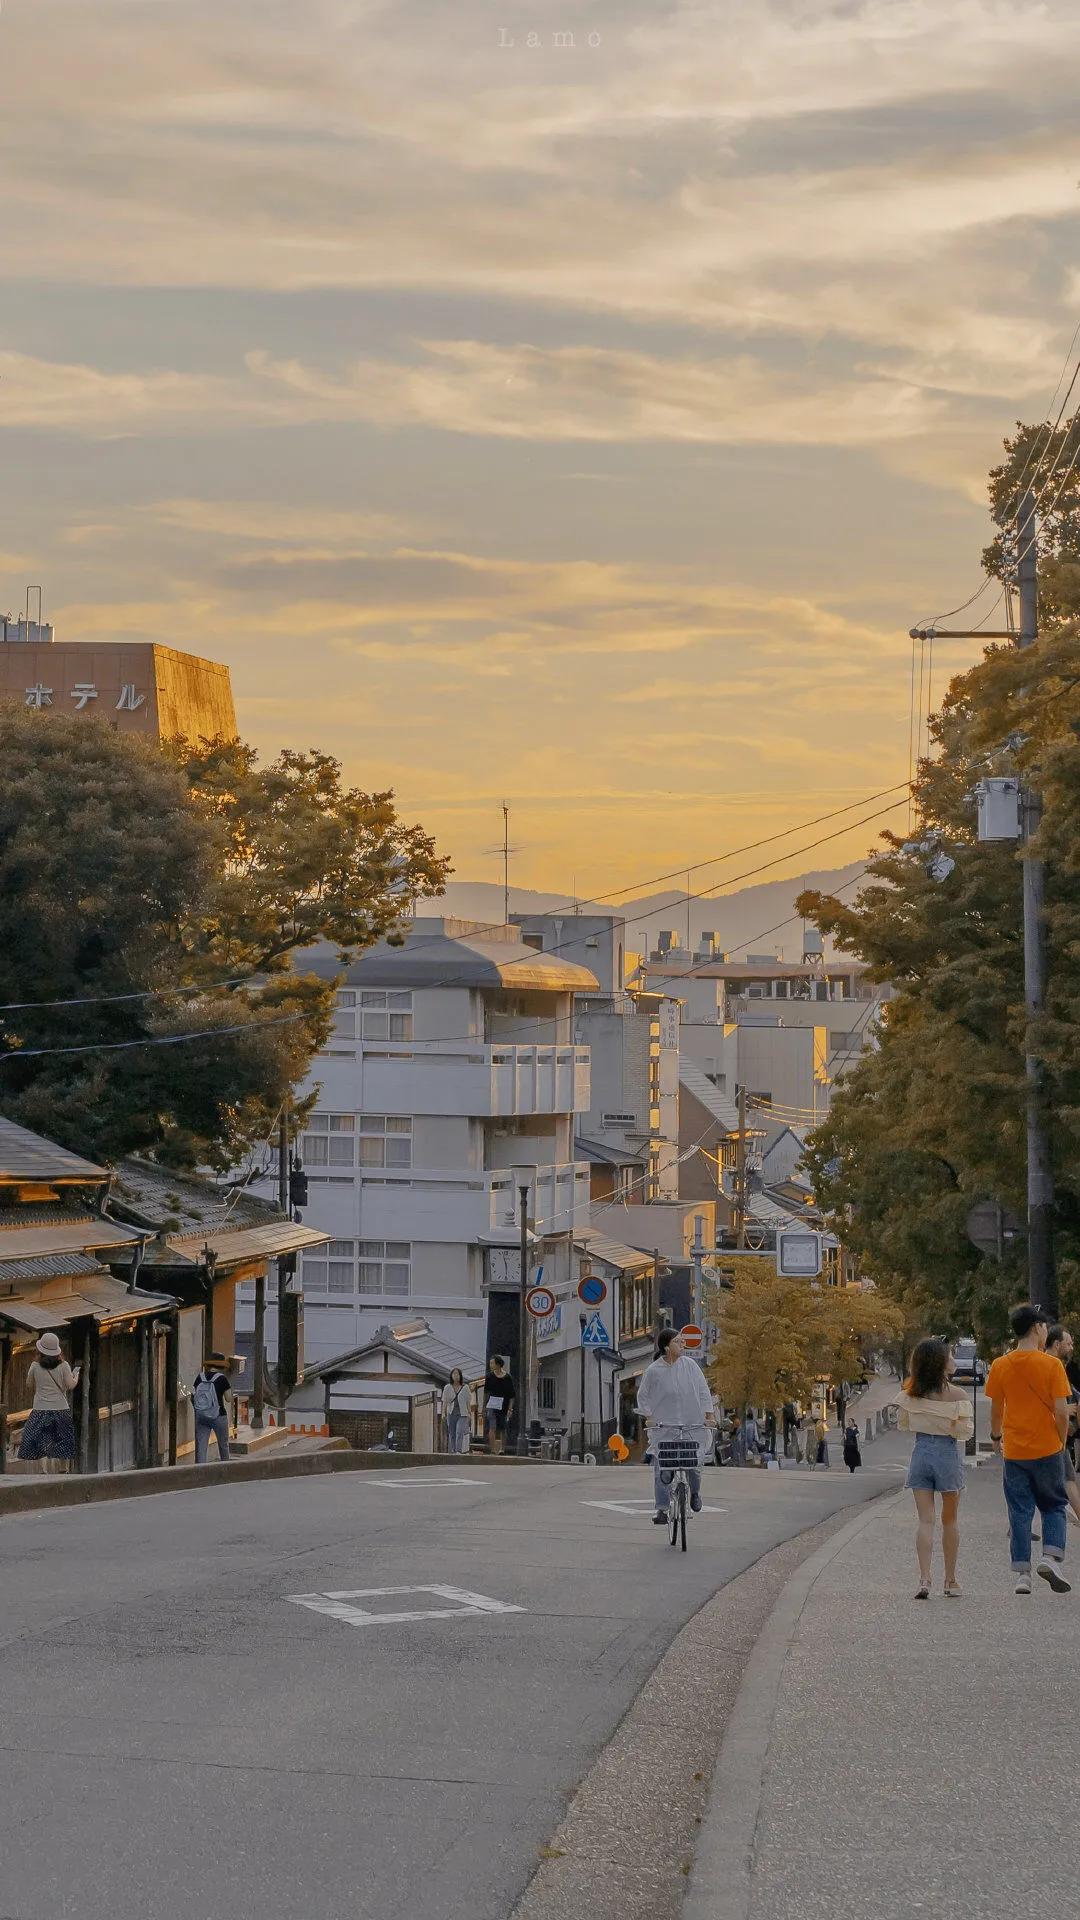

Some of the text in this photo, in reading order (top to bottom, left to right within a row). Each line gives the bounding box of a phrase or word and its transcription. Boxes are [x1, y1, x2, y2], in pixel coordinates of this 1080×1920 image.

[25, 683, 146, 711] ホテル
[532, 1296, 549, 1309] 30
